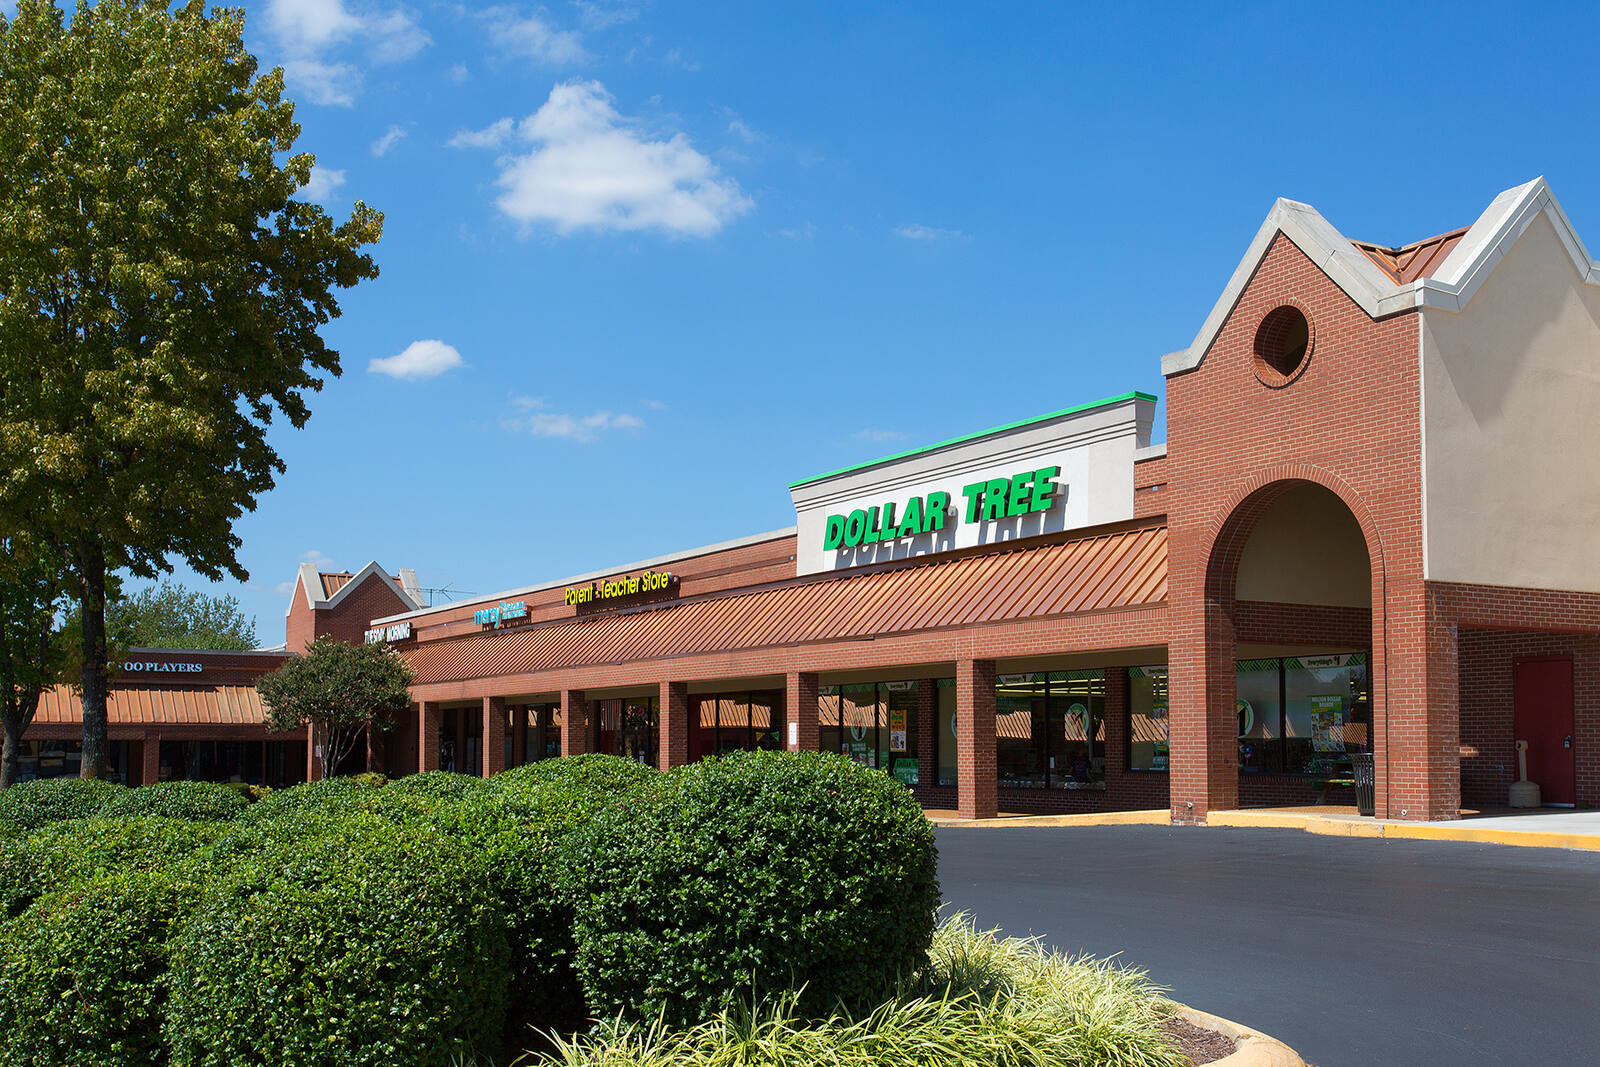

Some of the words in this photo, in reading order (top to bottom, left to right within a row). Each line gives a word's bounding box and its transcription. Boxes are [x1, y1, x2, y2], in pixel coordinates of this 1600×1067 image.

[823, 491, 950, 551] DOLLAR
[963, 466, 1058, 524] TREE
[565, 582, 593, 606] Parent
[601, 576, 640, 599] Teacher
[642, 570, 669, 592] Store
[474, 607, 500, 629] mercy
[144, 662, 202, 673] PLAYERS
